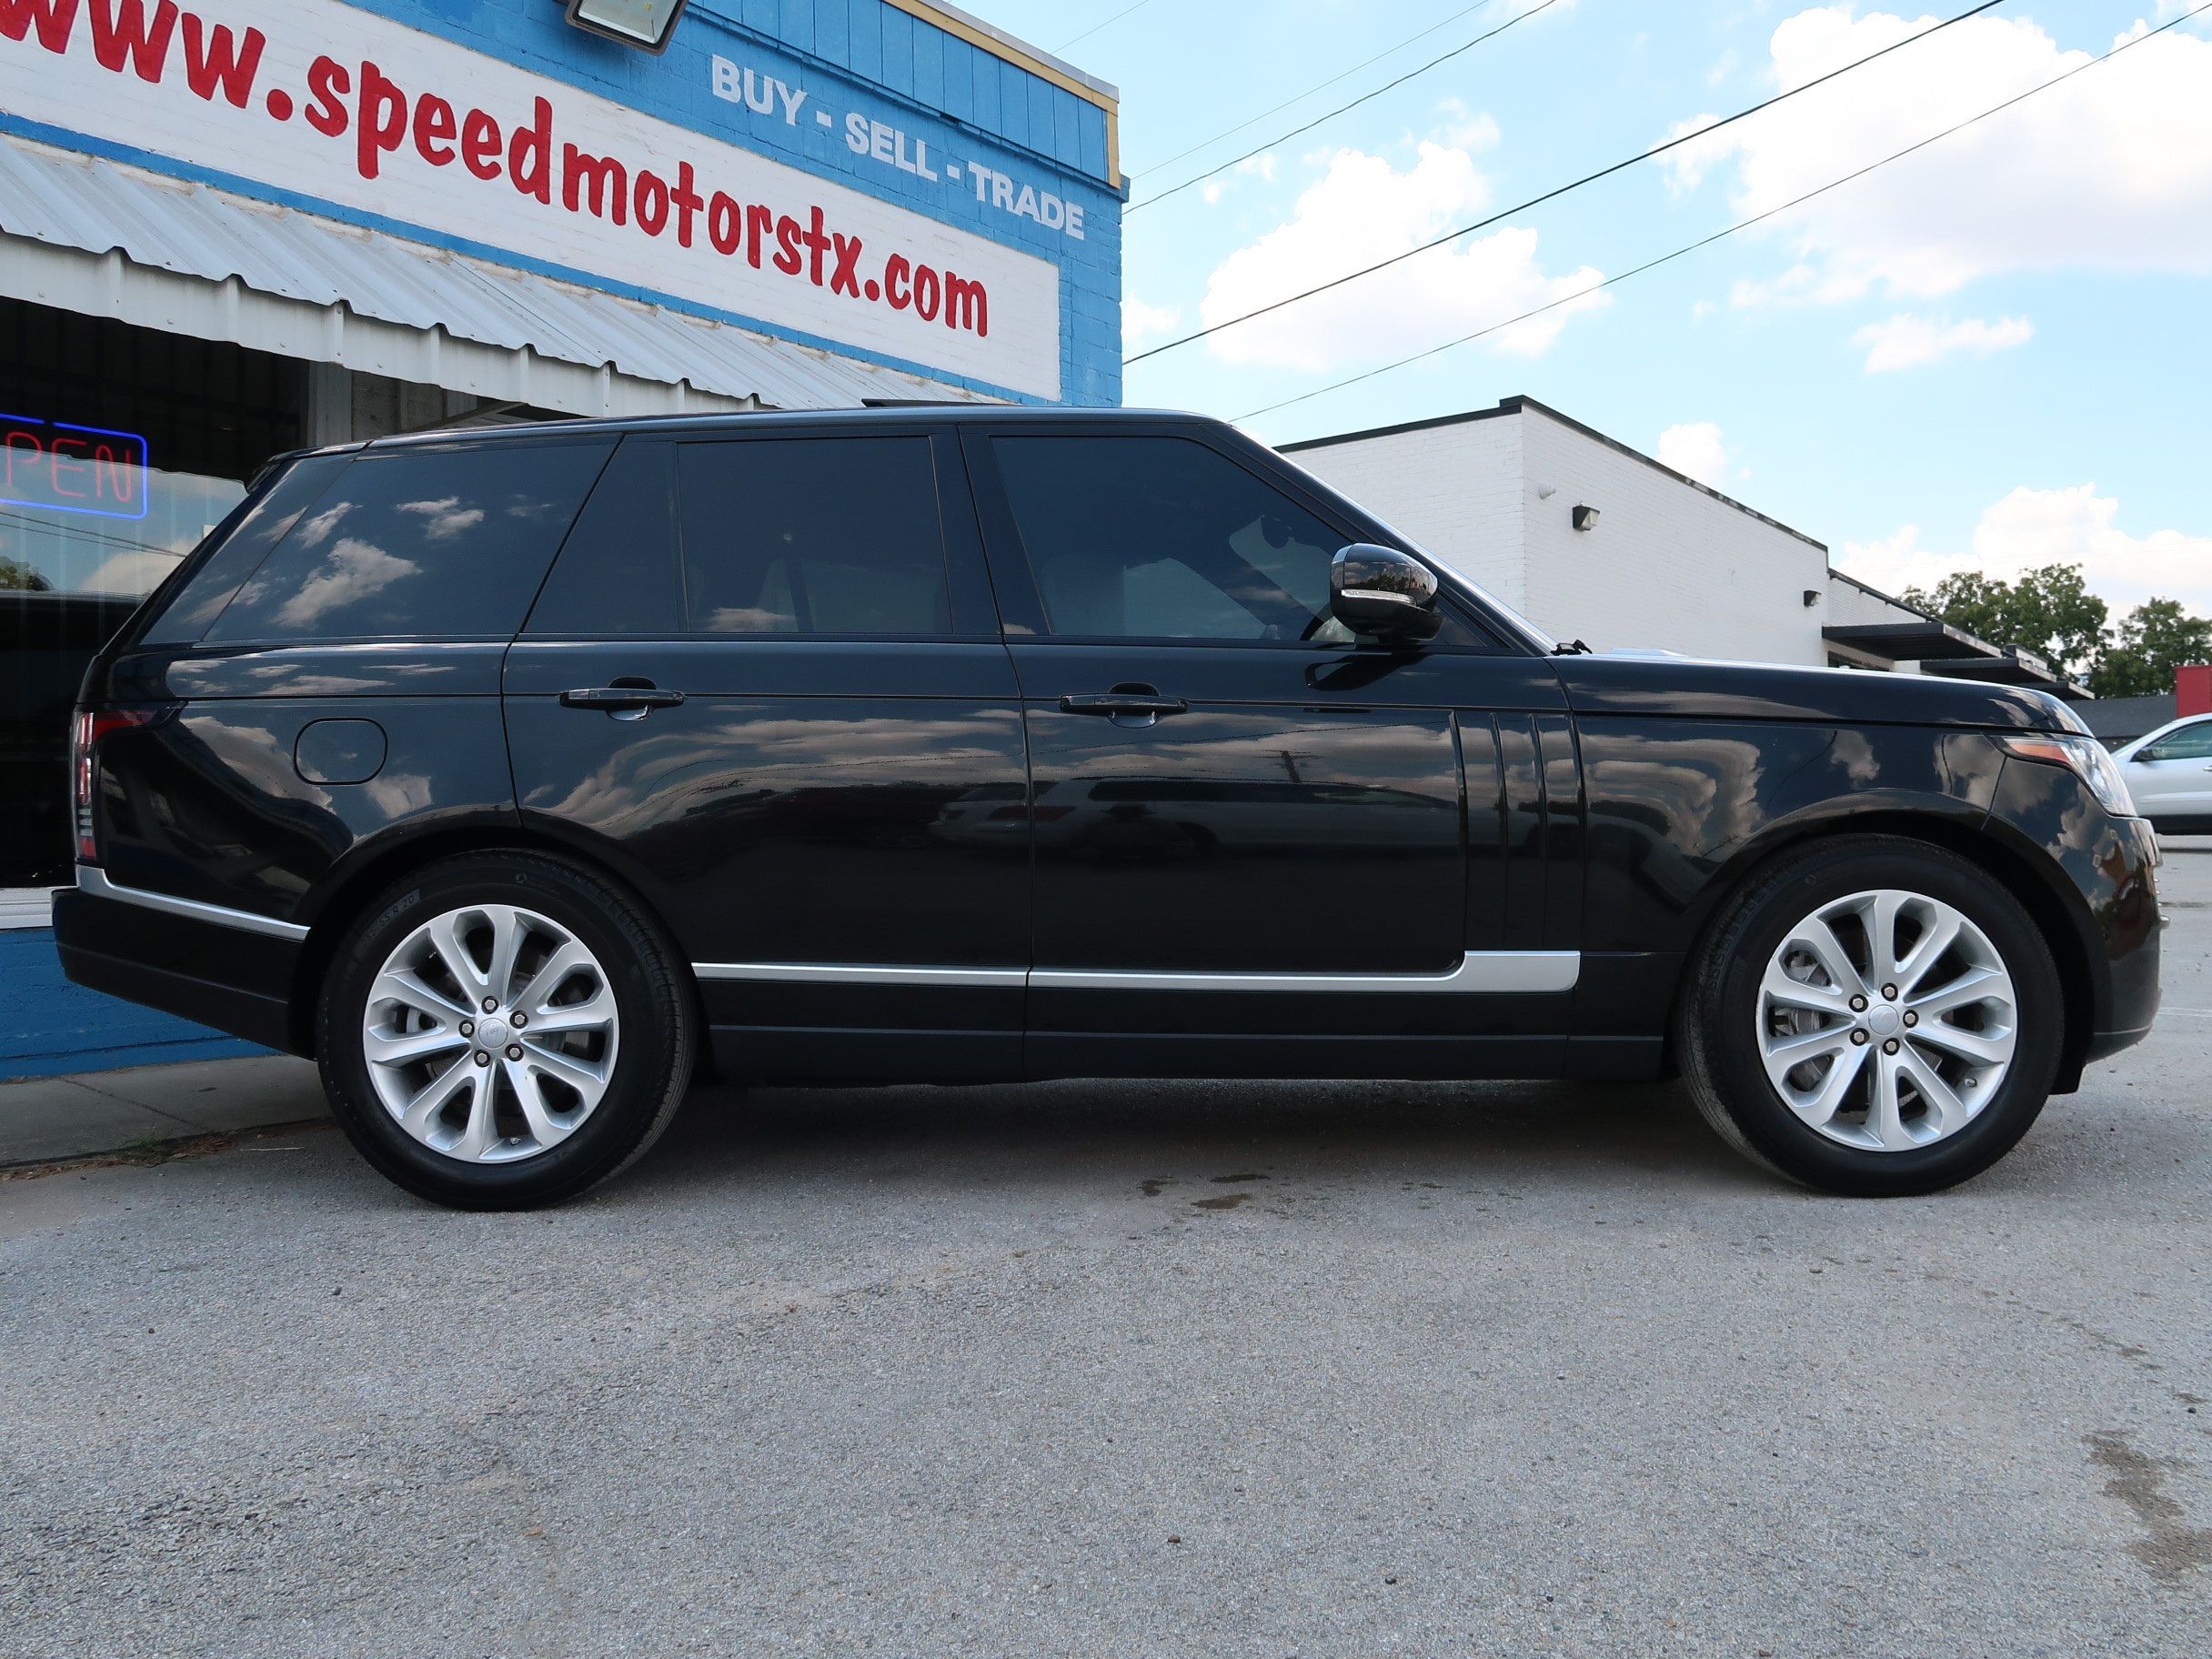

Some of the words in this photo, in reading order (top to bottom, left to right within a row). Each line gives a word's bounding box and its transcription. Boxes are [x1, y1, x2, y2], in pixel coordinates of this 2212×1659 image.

[0, 0, 988, 337] www.speedmotorstx.com
[711, 54, 808, 126] BUY
[844, 112, 938, 182] SELL
[968, 160, 1085, 240] TRADE
